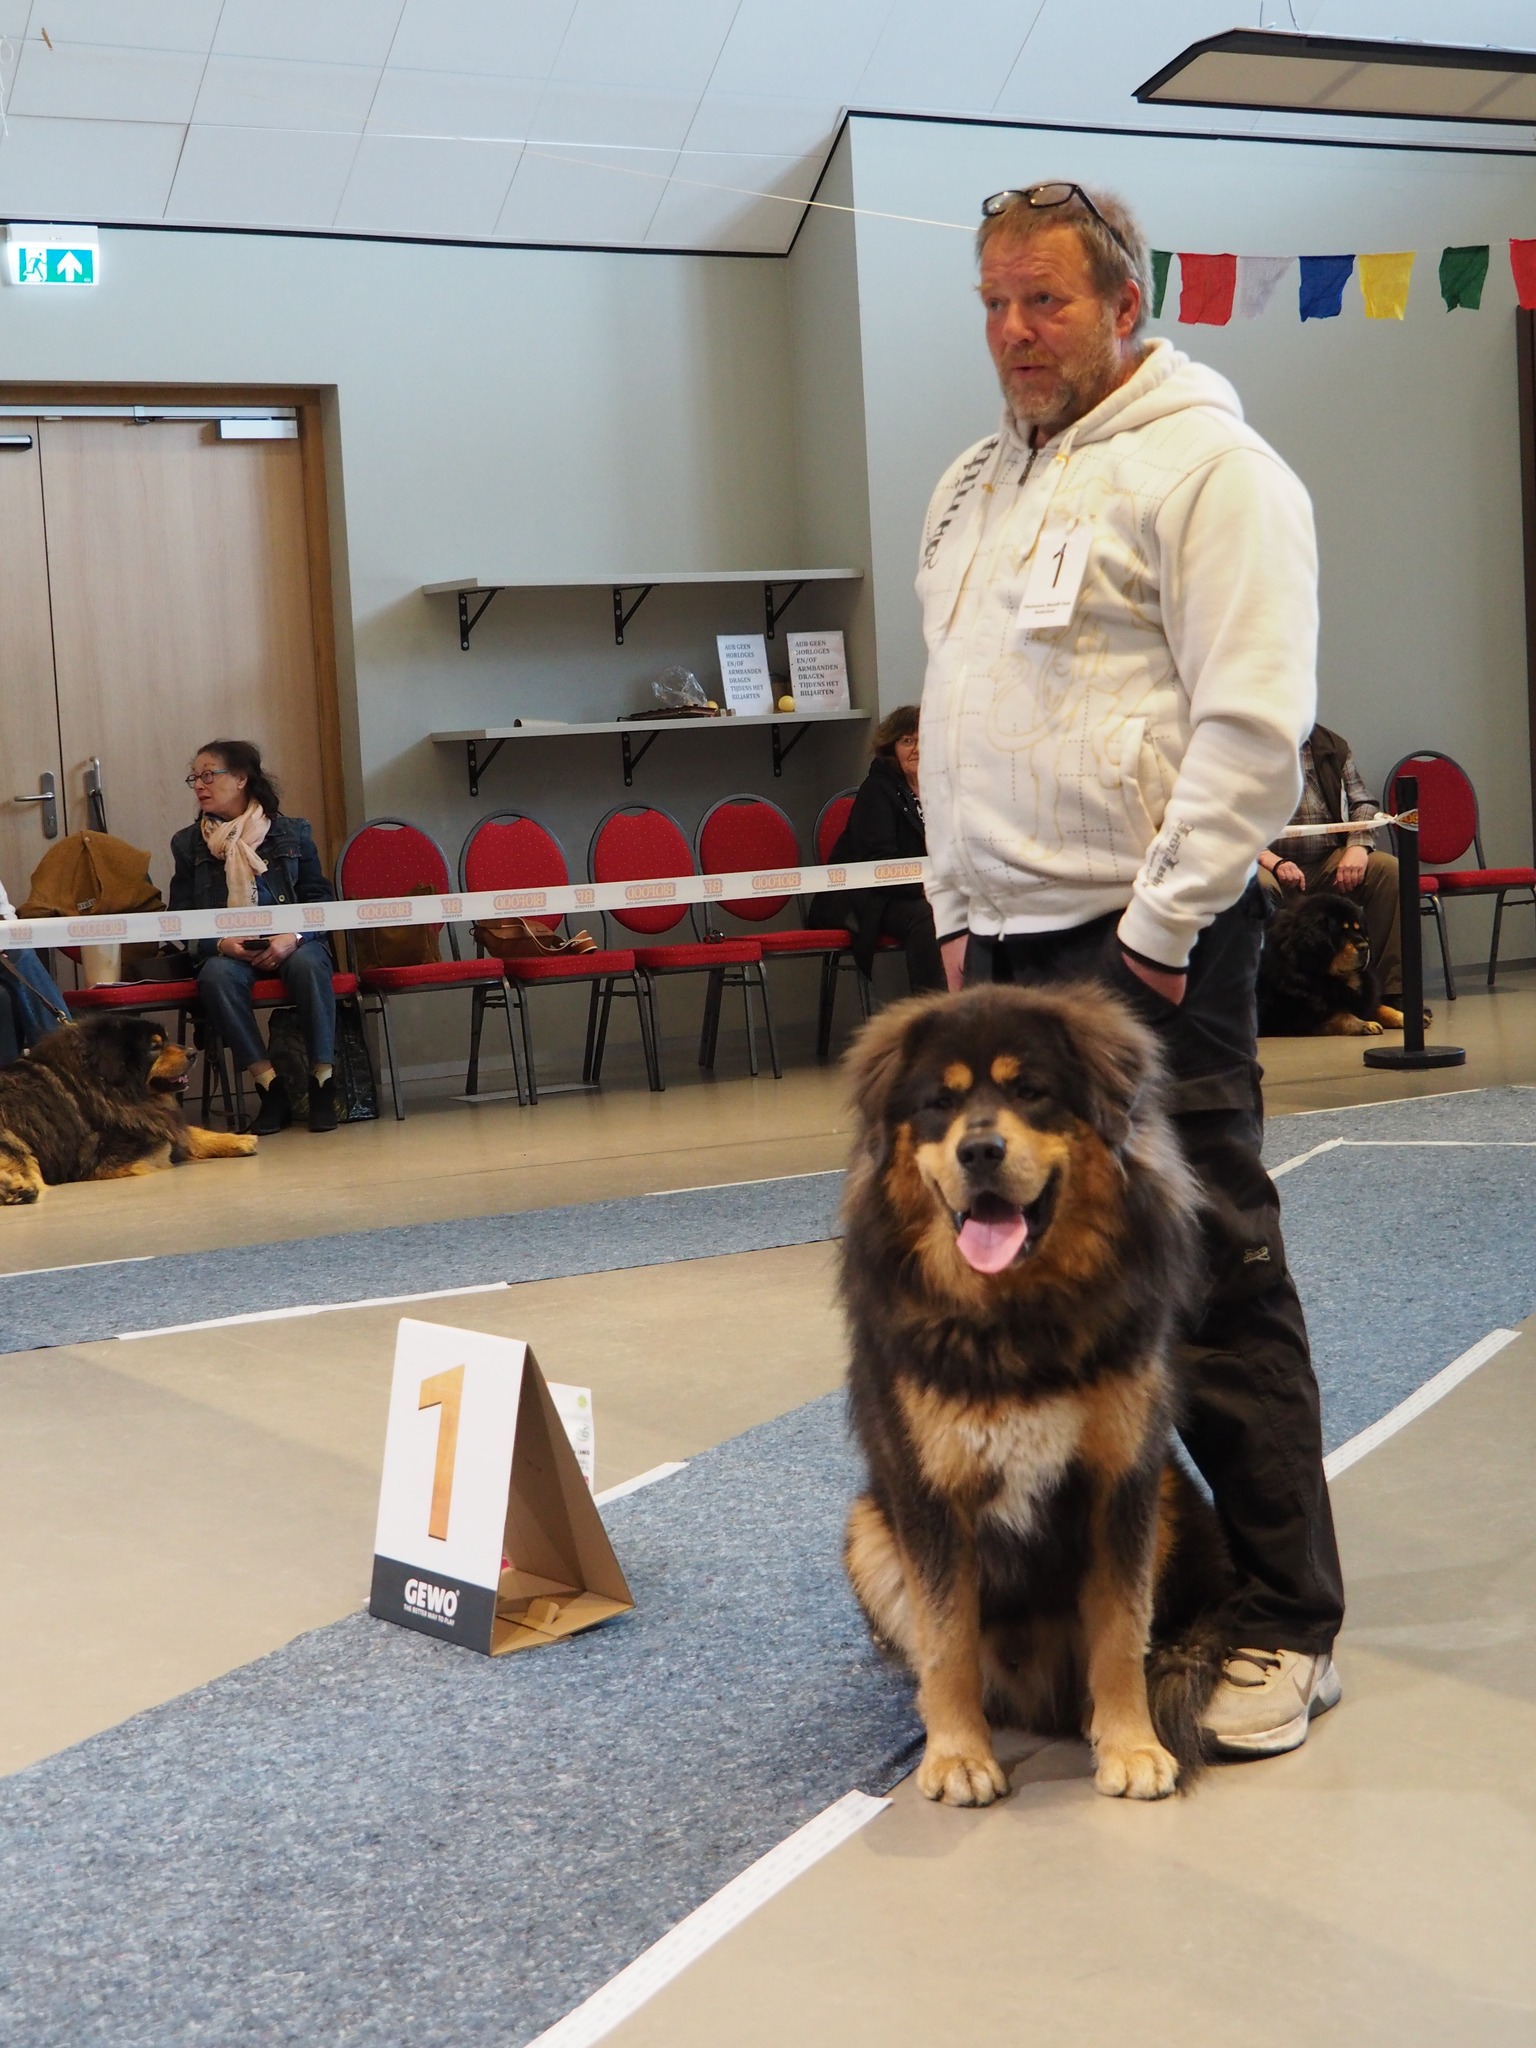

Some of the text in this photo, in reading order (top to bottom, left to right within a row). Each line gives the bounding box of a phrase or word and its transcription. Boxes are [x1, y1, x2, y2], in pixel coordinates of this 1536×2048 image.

[1052, 542, 1067, 588] 1
[797, 664, 839, 672] ARMBANDEN
[799, 681, 825, 689] TIJDENS
[800, 689, 834, 697] BILJARTEN
[418, 1363, 465, 1541] 1
[404, 1578, 458, 1618] GEWO
